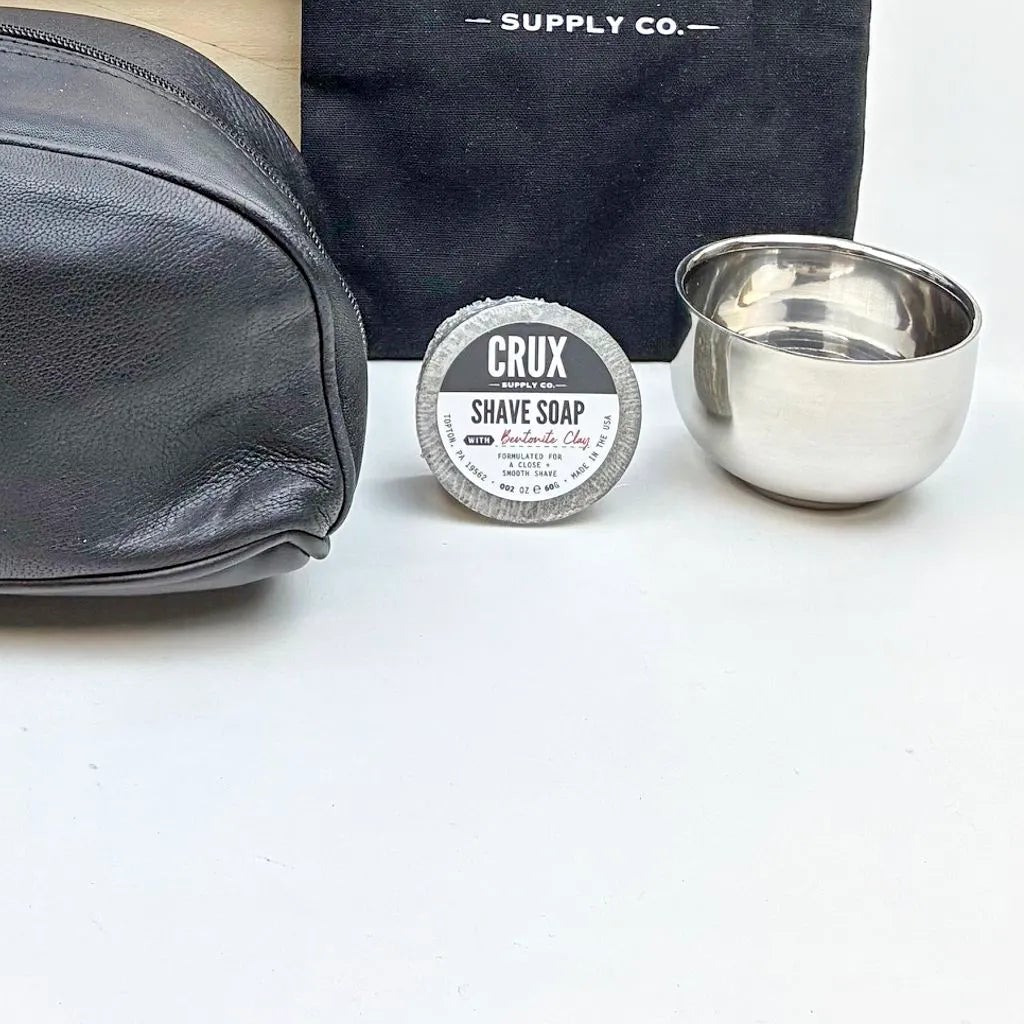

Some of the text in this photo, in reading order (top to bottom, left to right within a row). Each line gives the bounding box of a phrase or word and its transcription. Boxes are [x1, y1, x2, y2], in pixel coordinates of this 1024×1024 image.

[500, 12, 685, 36] SUPPLY CO.
[488, 335, 568, 378] CRUX
[501, 381, 556, 389] SUPPLY CO.
[471, 399, 585, 425] SHAVE SOAP
[467, 429, 590, 450] WITH Bentonite Clay
[456, 449, 466, 461] PA
[465, 462, 488, 481] 19562
[499, 483, 515, 493] 002
[519, 486, 529, 494] OZ
[544, 482, 560, 492] 60G
[571, 463, 590, 480] MADE
[588, 451, 599, 462] IN
[596, 434, 608, 448] THE
[603, 415, 612, 430] USA
